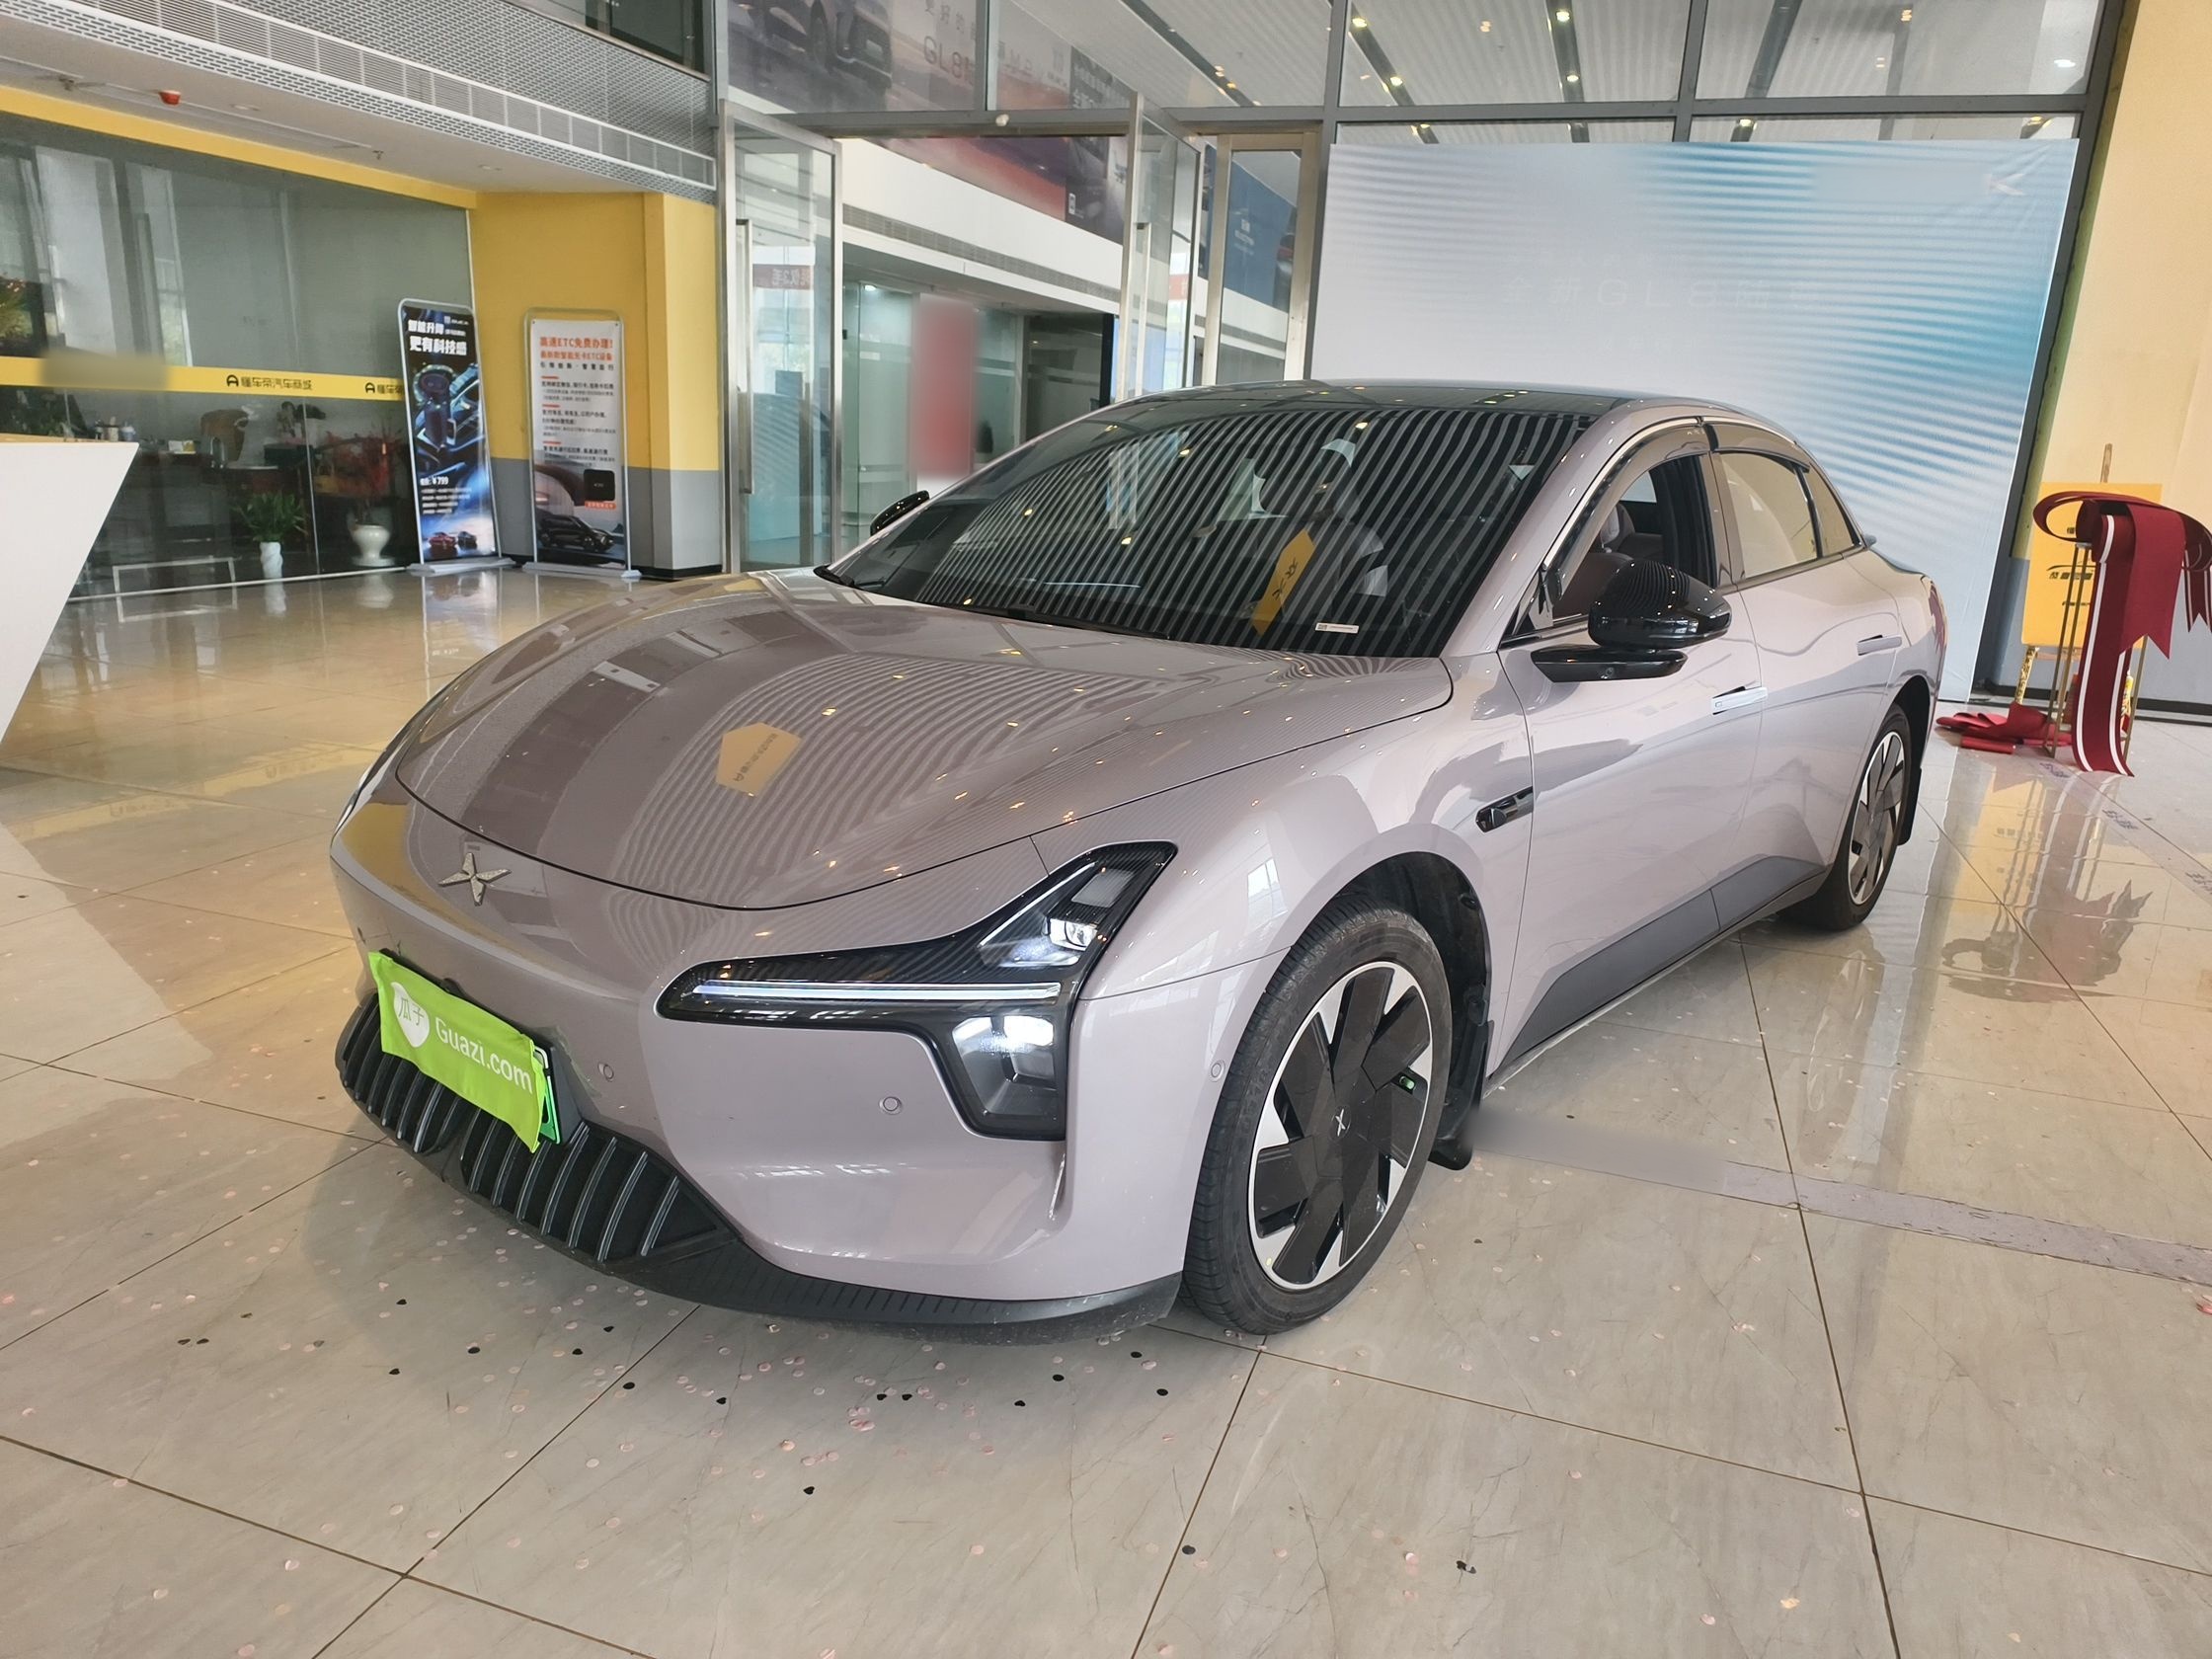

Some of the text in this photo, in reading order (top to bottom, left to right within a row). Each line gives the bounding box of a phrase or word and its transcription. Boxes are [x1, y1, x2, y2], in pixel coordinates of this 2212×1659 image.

[410, 335, 467, 356] 更有科技感
[398, 996, 425, 1026] 瓜子
[435, 1017, 533, 1095] Guazi.com
